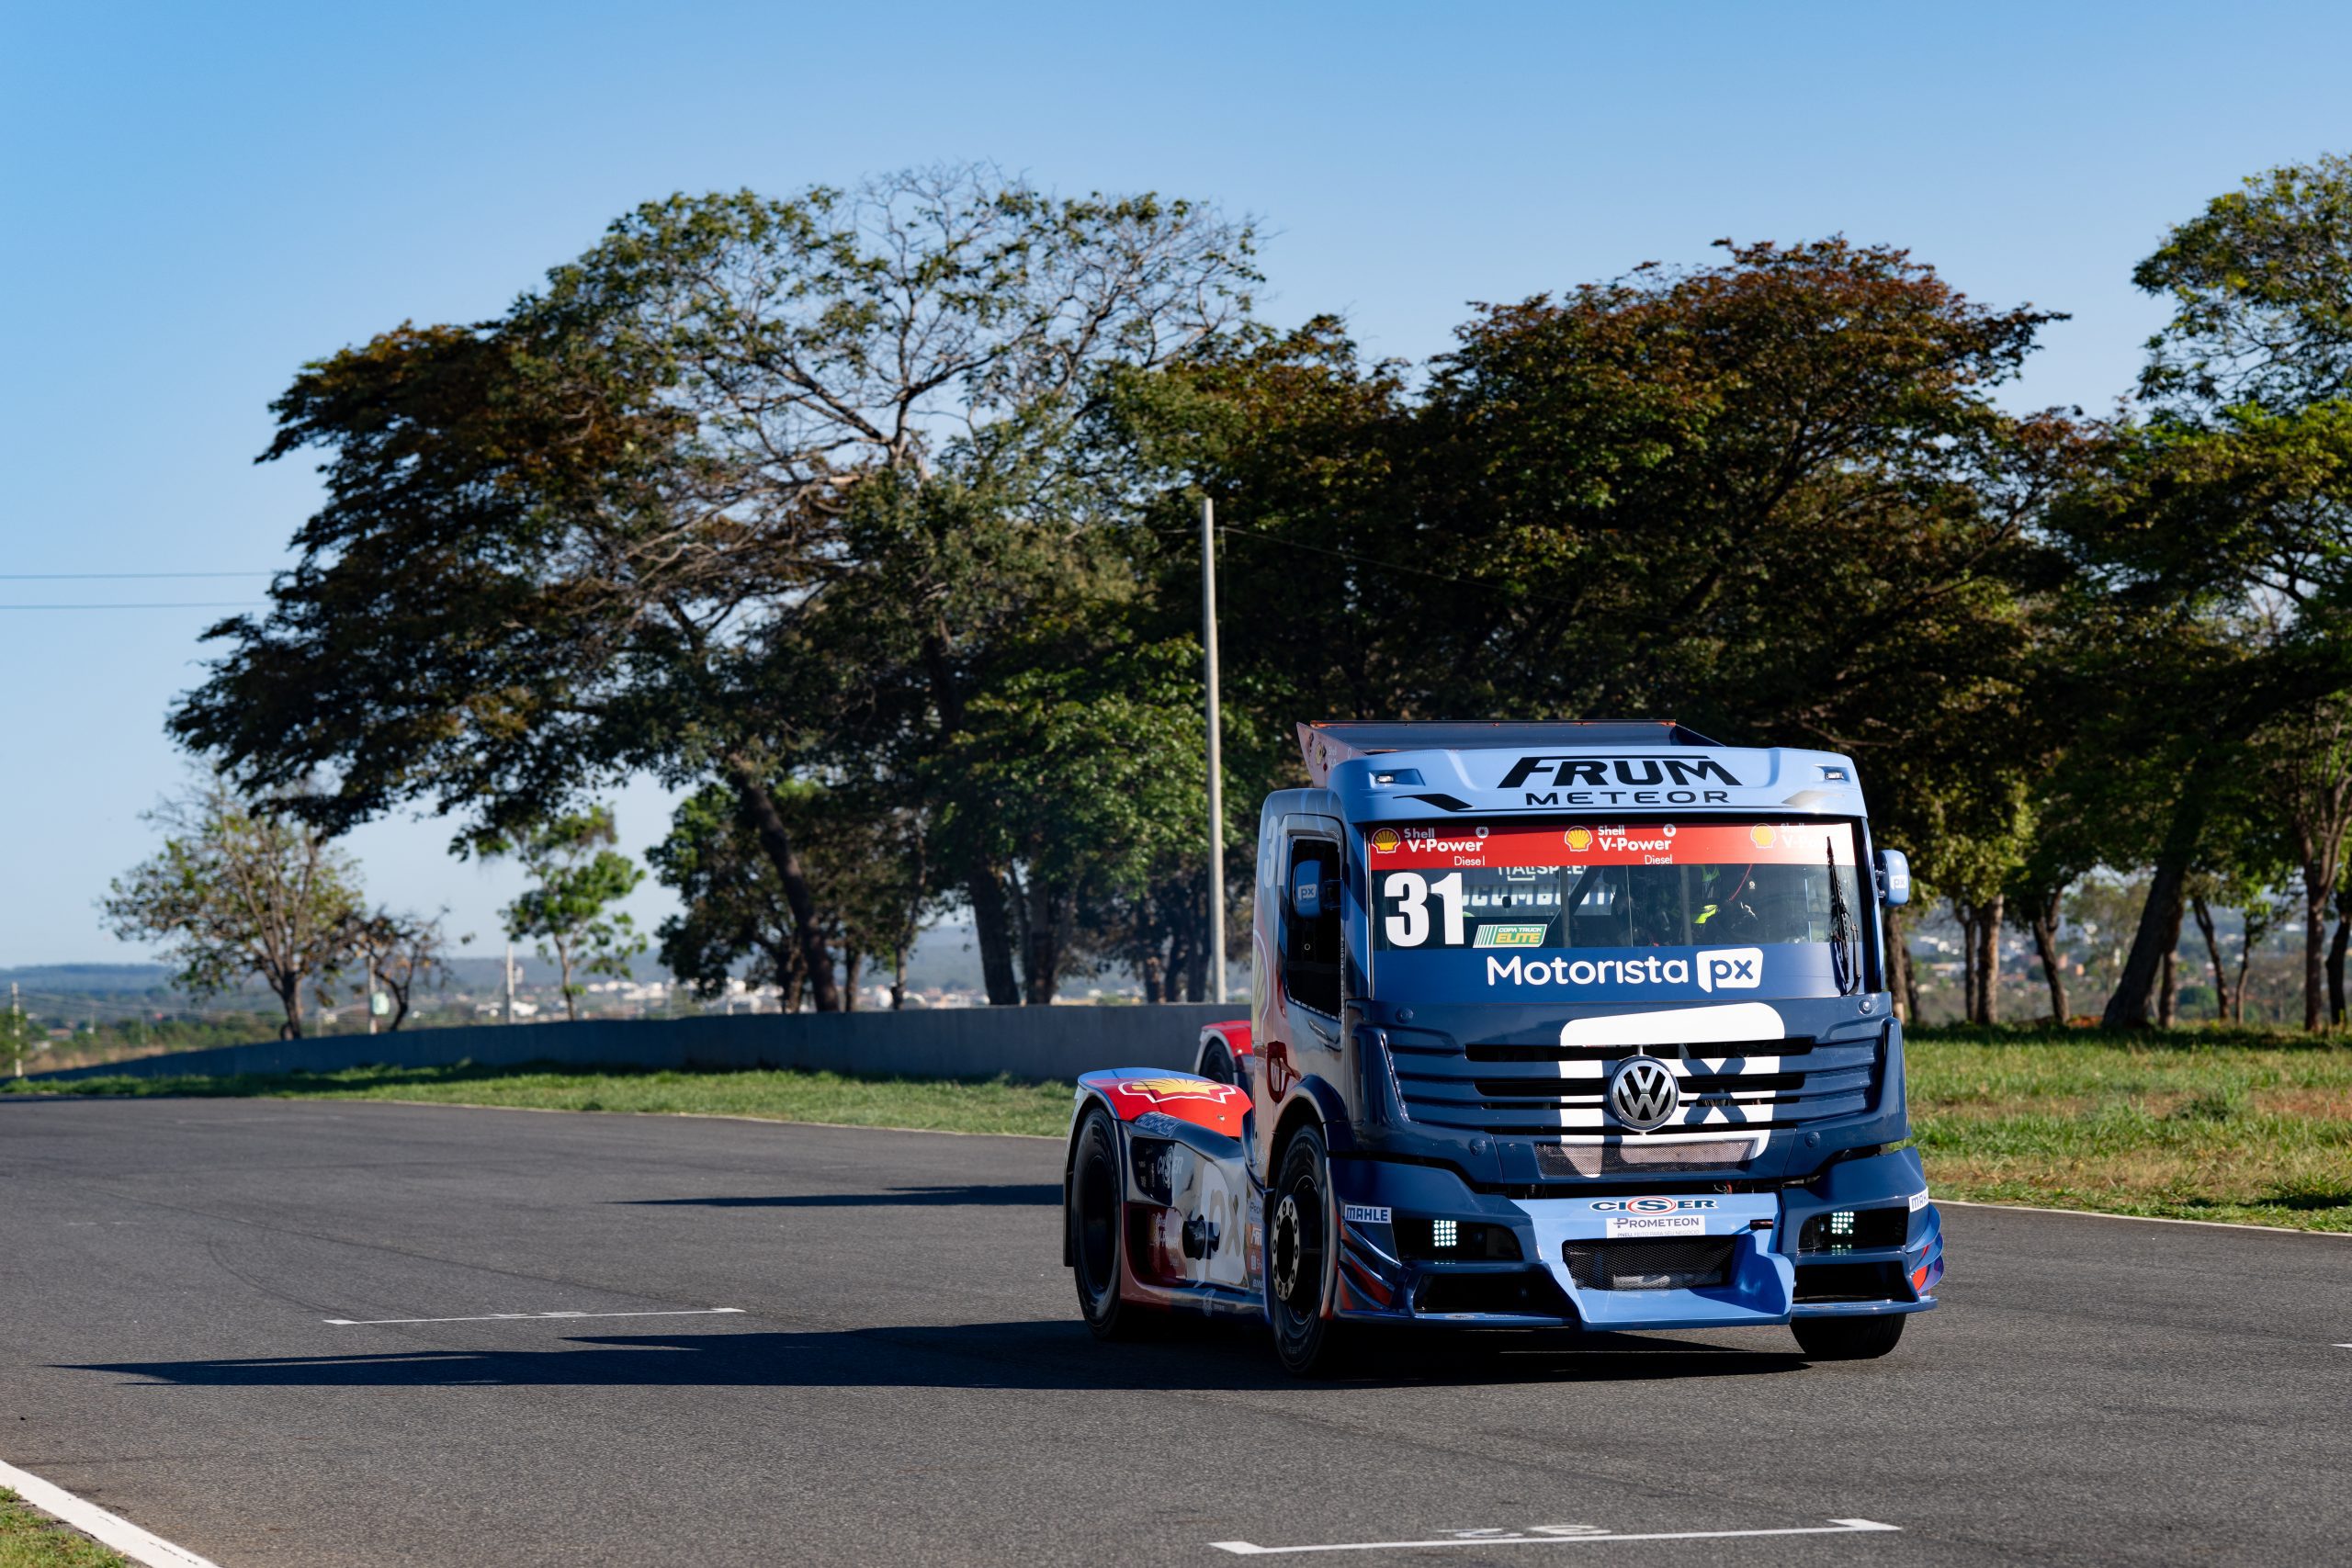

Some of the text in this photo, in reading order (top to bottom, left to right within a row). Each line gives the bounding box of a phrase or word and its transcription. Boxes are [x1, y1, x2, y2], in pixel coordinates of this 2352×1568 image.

[1497, 755, 1744, 788] FRUM
[1525, 791, 1731, 806] METEOR
[1404, 828, 1435, 839] Shell
[1598, 825, 1625, 836] Shell
[1408, 839, 1483, 852] V-Power
[1598, 837, 1672, 852] V-Power
[1454, 855, 1486, 866] Diesel
[1644, 854, 1672, 865] Diesel
[1301, 887, 1315, 899] px
[1385, 872, 1464, 947] 31
[1496, 933, 1541, 943] ELITE
[1487, 956, 1689, 986] Motorista
[1710, 959, 1753, 988] px
[1590, 1199, 1716, 1212] CISER
[1346, 1207, 1388, 1222] MAHLE
[1614, 1217, 1700, 1229] PROMETEON
